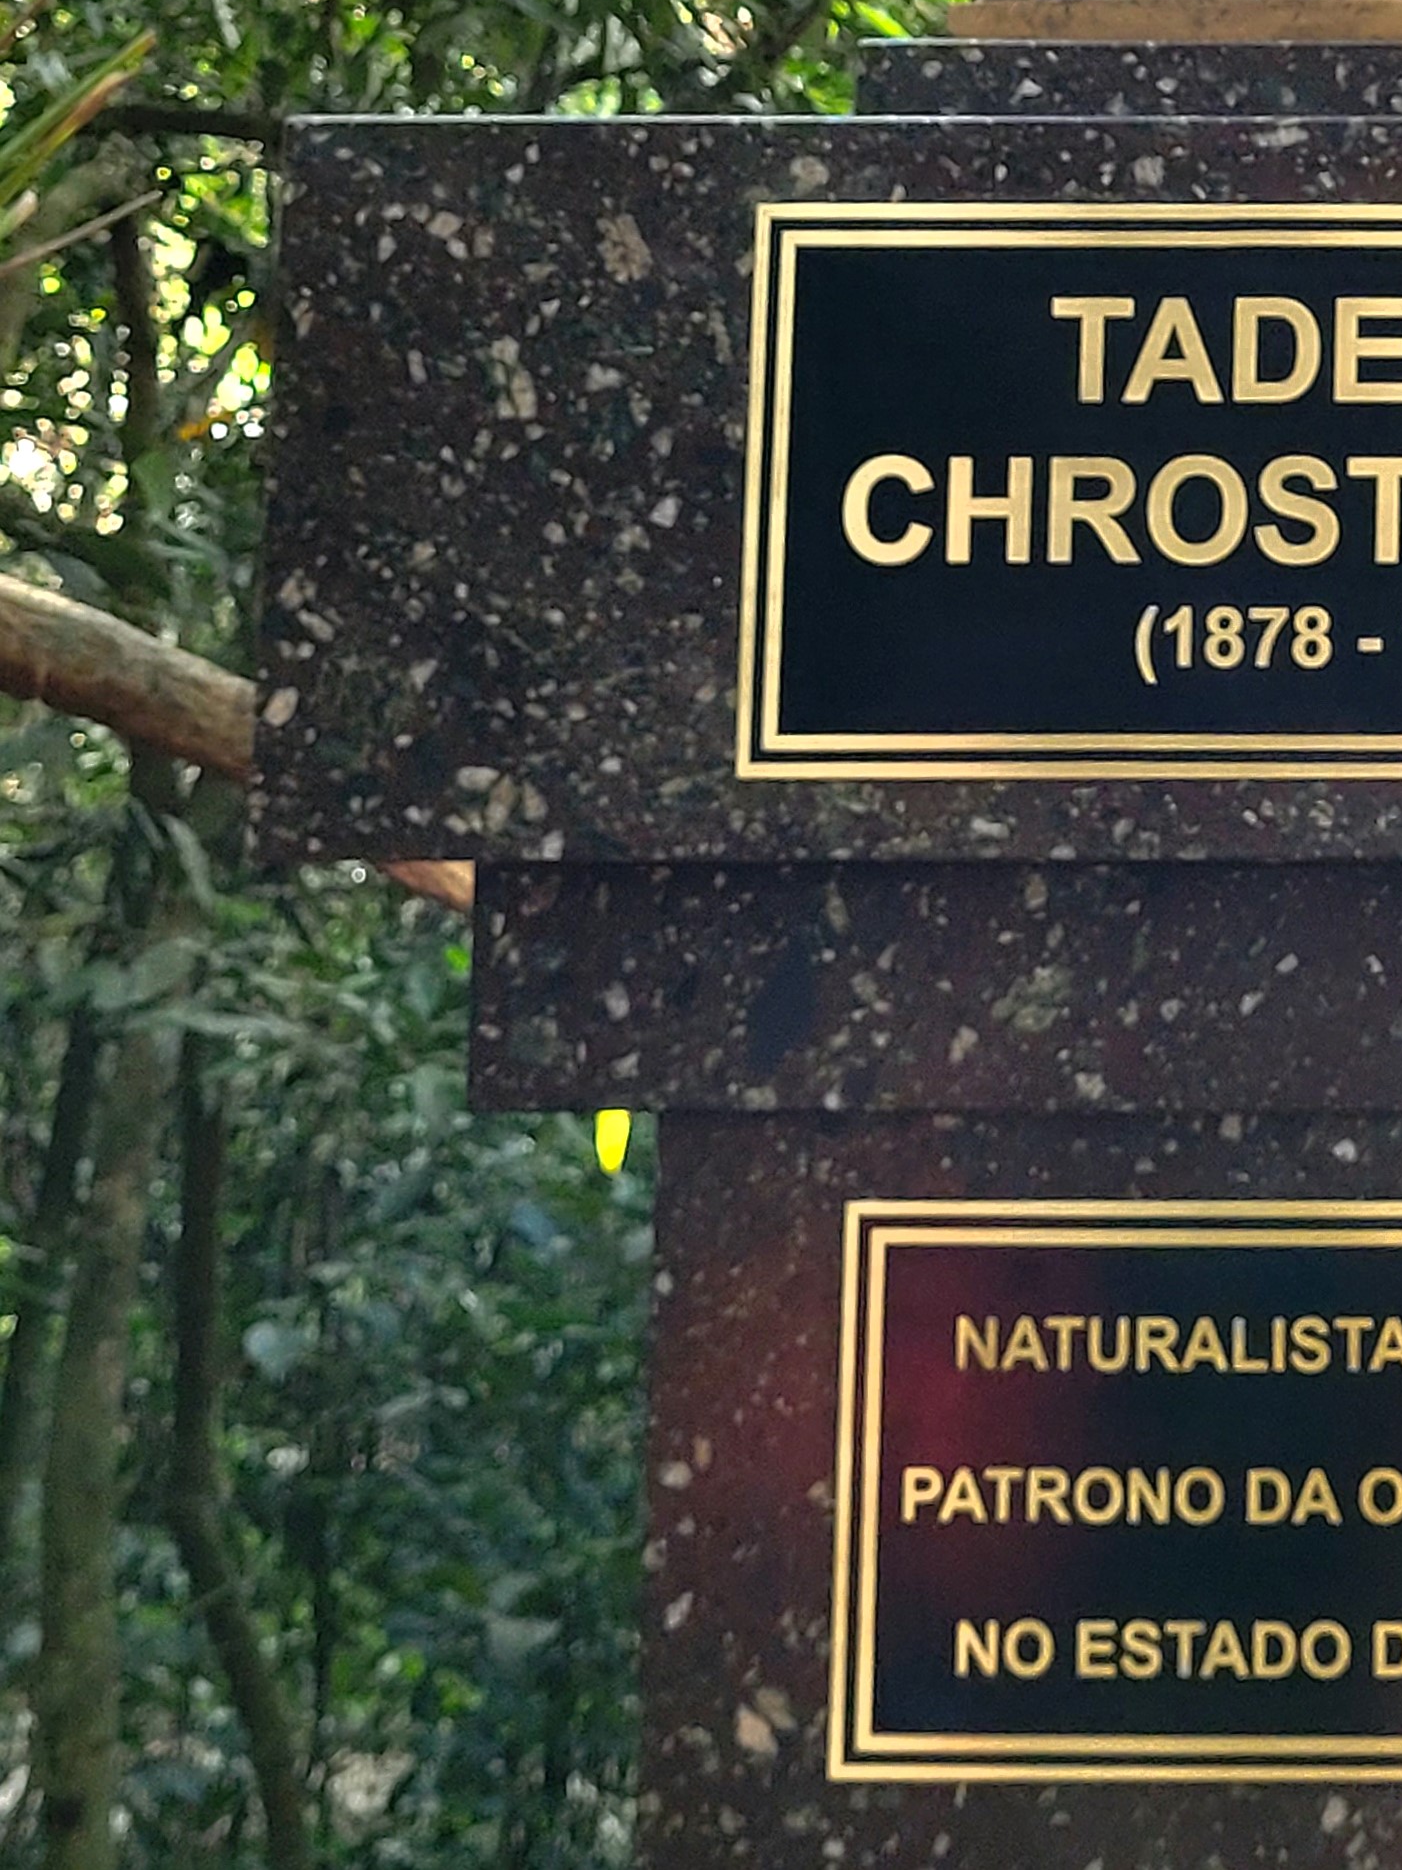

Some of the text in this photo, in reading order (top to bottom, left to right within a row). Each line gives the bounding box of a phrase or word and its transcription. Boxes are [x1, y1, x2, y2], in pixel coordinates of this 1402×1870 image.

[1135, 605, 1334, 685] (1878
[1357, 636, 1383, 653] -
[902, 1467, 1226, 1524] PATRONO
[1246, 1468, 1341, 1524] DA
[955, 1618, 1052, 1678] NO
[1075, 1621, 1351, 1678] ESTADO
